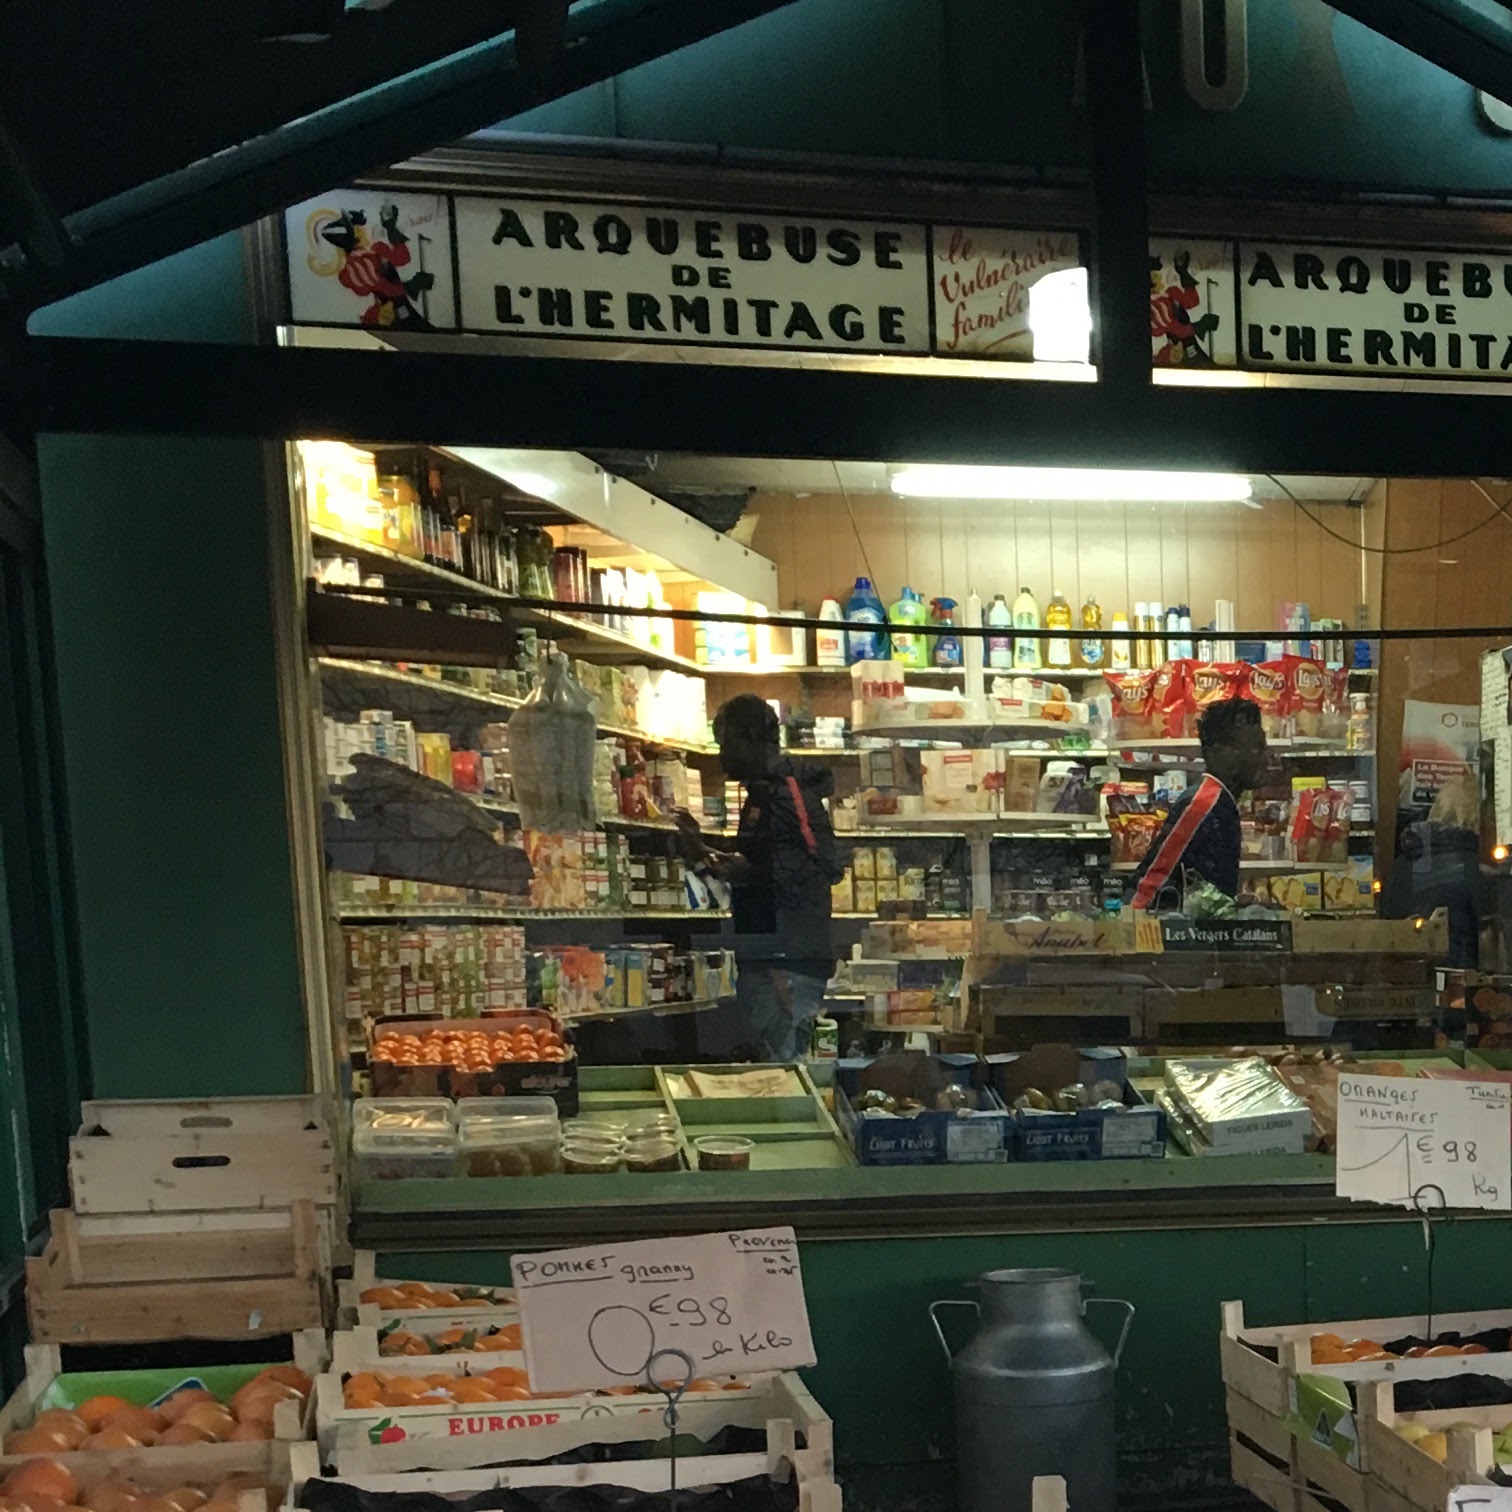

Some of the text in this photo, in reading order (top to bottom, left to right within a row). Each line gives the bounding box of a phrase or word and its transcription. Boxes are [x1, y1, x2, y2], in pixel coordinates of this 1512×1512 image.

[490, 208, 904, 270] ARQUEBUSE
[672, 264, 731, 290] DE
[494, 286, 906, 344] L'HERMITAGE
[946, 284, 1031, 352] famili
[1403, 302, 1457, 326] DE
[1166, 927, 1278, 943] Les Vergers Catalans
[1339, 1081, 1420, 1105] ORANGES
[1360, 1108, 1439, 1124] MALTAISES
[1471, 1174, 1499, 1202] Kg
[516, 1255, 616, 1281] POMMES
[447, 1413, 561, 1437] EUROPE
